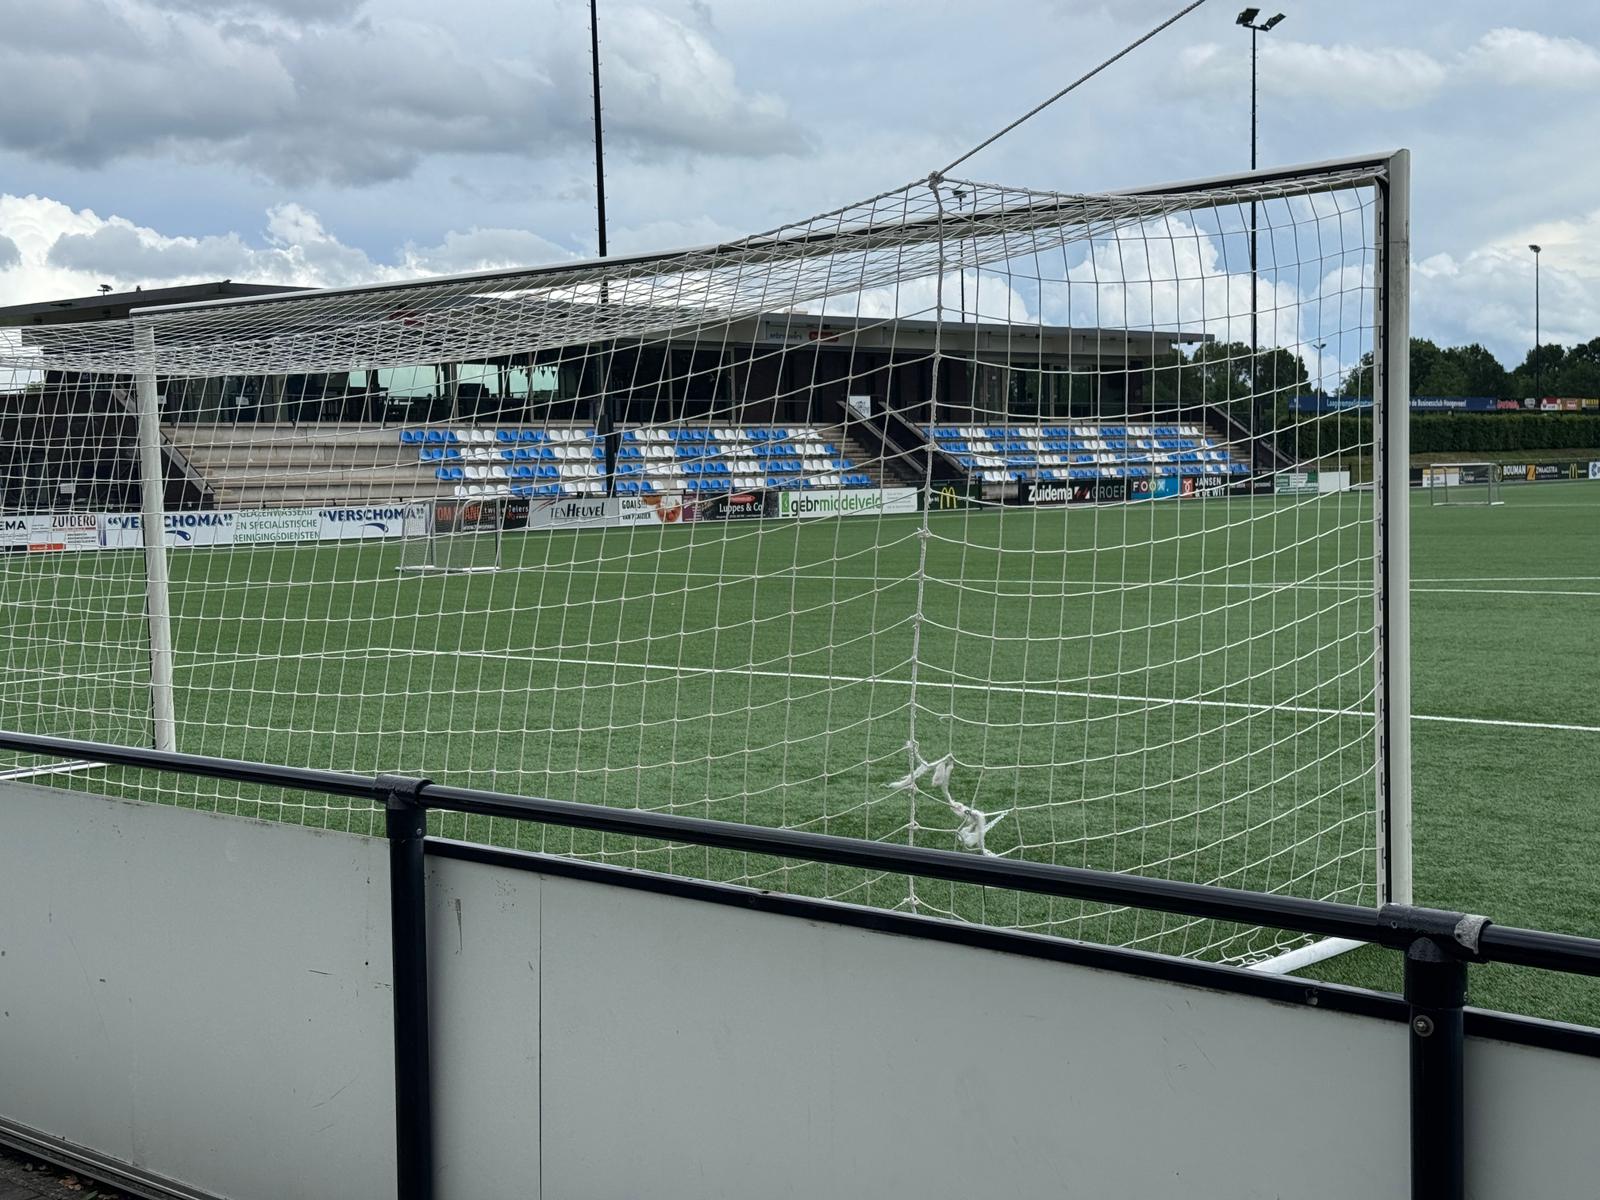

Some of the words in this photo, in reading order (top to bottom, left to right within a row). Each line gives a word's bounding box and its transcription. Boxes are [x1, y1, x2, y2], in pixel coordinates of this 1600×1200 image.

[1195, 476, 1221, 486] JANSEN
[1028, 485, 1073, 502] Zuidema
[1091, 485, 1127, 499] GROEP
[1212, 487, 1225, 496] WIT
[621, 499, 642, 509] GOALS
[719, 503, 744, 514] Luppes
[746, 503, 752, 511] &
[52, 514, 97, 528] ZUIDERO
[250, 519, 318, 530] SPECIALISTISCHE
[232, 530, 320, 542] REINIGINGSDIENSTEN
